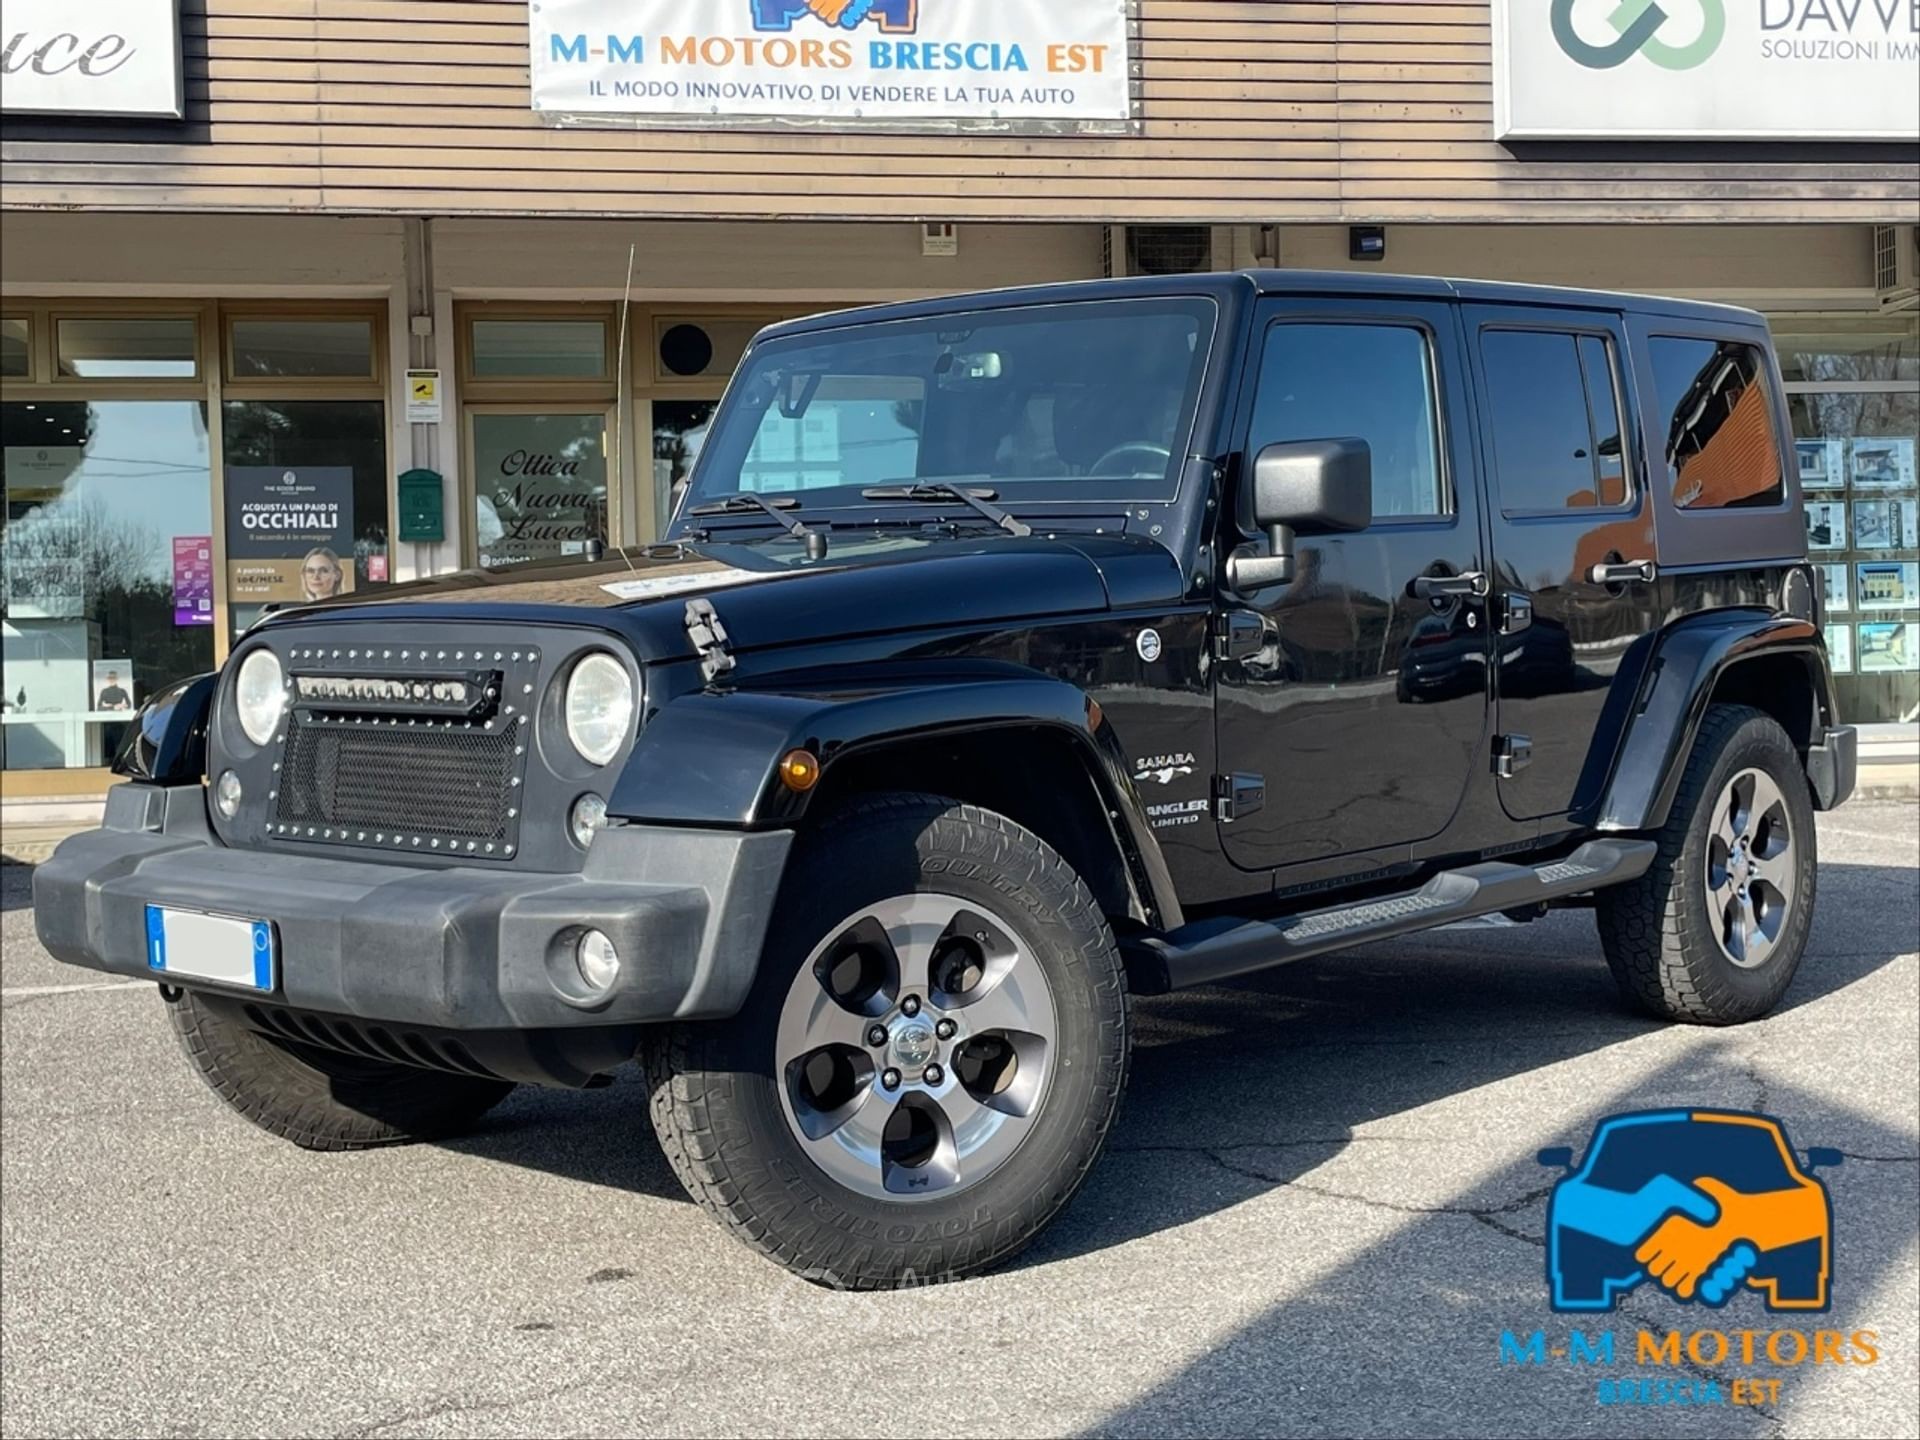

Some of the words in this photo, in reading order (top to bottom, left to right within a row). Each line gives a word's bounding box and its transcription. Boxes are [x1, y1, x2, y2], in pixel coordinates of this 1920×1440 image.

[550, 33, 644, 64] M-M
[660, 36, 852, 69] MOTORS
[869, 40, 1029, 72] BRESCIA
[1046, 44, 1108, 73] EST
[1760, 39, 1879, 60] SOLUZIONI
[589, 80, 608, 97] IL
[614, 81, 679, 98] MODO
[686, 82, 813, 101] INNOVATIVO
[821, 85, 840, 100] DI
[848, 86, 938, 102] VENDERE
[944, 87, 969, 103] LA
[974, 87, 1014, 104] TUA
[1020, 88, 1075, 105] AUTO
[500, 449, 580, 476] Ottica
[241, 503, 288, 512] ACQUISTA
[289, 503, 303, 512] UN
[304, 503, 327, 512] PAIO
[328, 503, 339, 512] DI
[492, 481, 590, 510] Nuova
[241, 512, 338, 529] OCCHIALI
[505, 514, 587, 541] Luce
[1135, 752, 1196, 770] SAHARA
